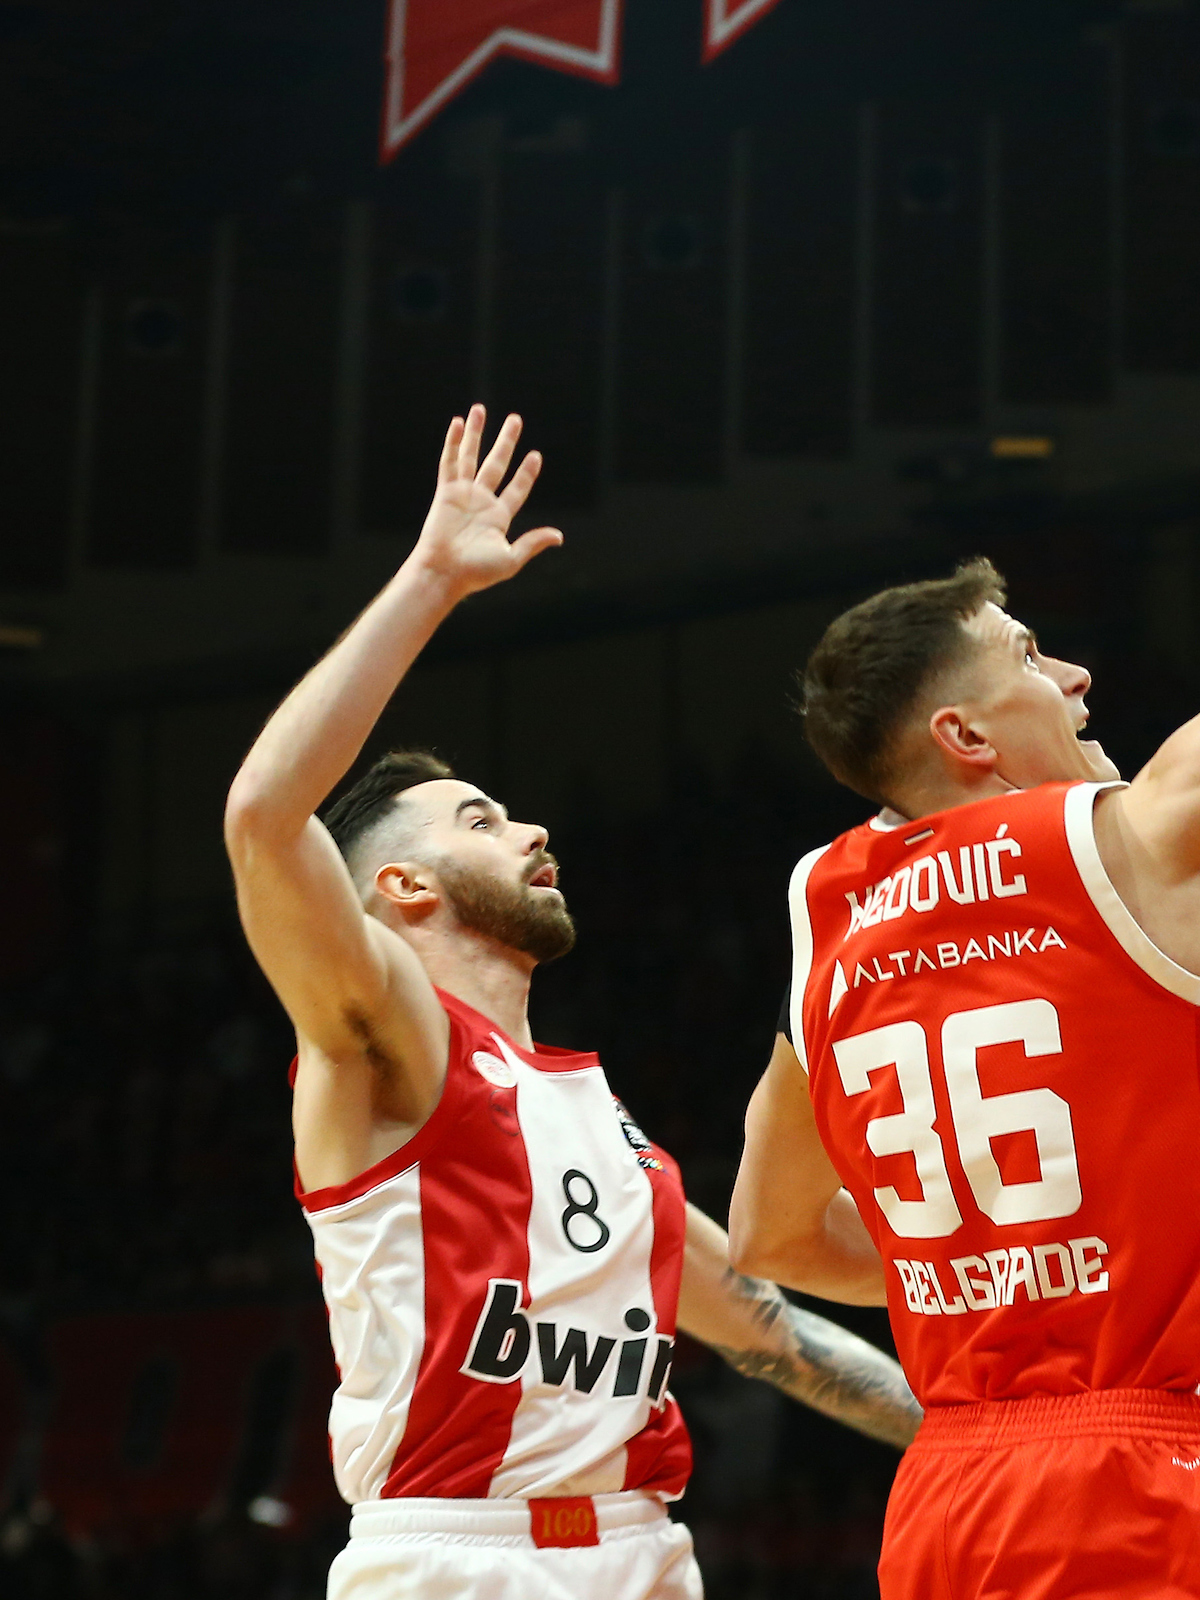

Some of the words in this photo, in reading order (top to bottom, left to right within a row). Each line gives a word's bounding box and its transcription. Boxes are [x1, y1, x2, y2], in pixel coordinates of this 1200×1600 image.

[831, 997, 1083, 1239] 36
[562, 1168, 610, 1253] 8
[892, 1235, 1110, 1316] BELGRADE
[542, 1506, 591, 1538] 100
